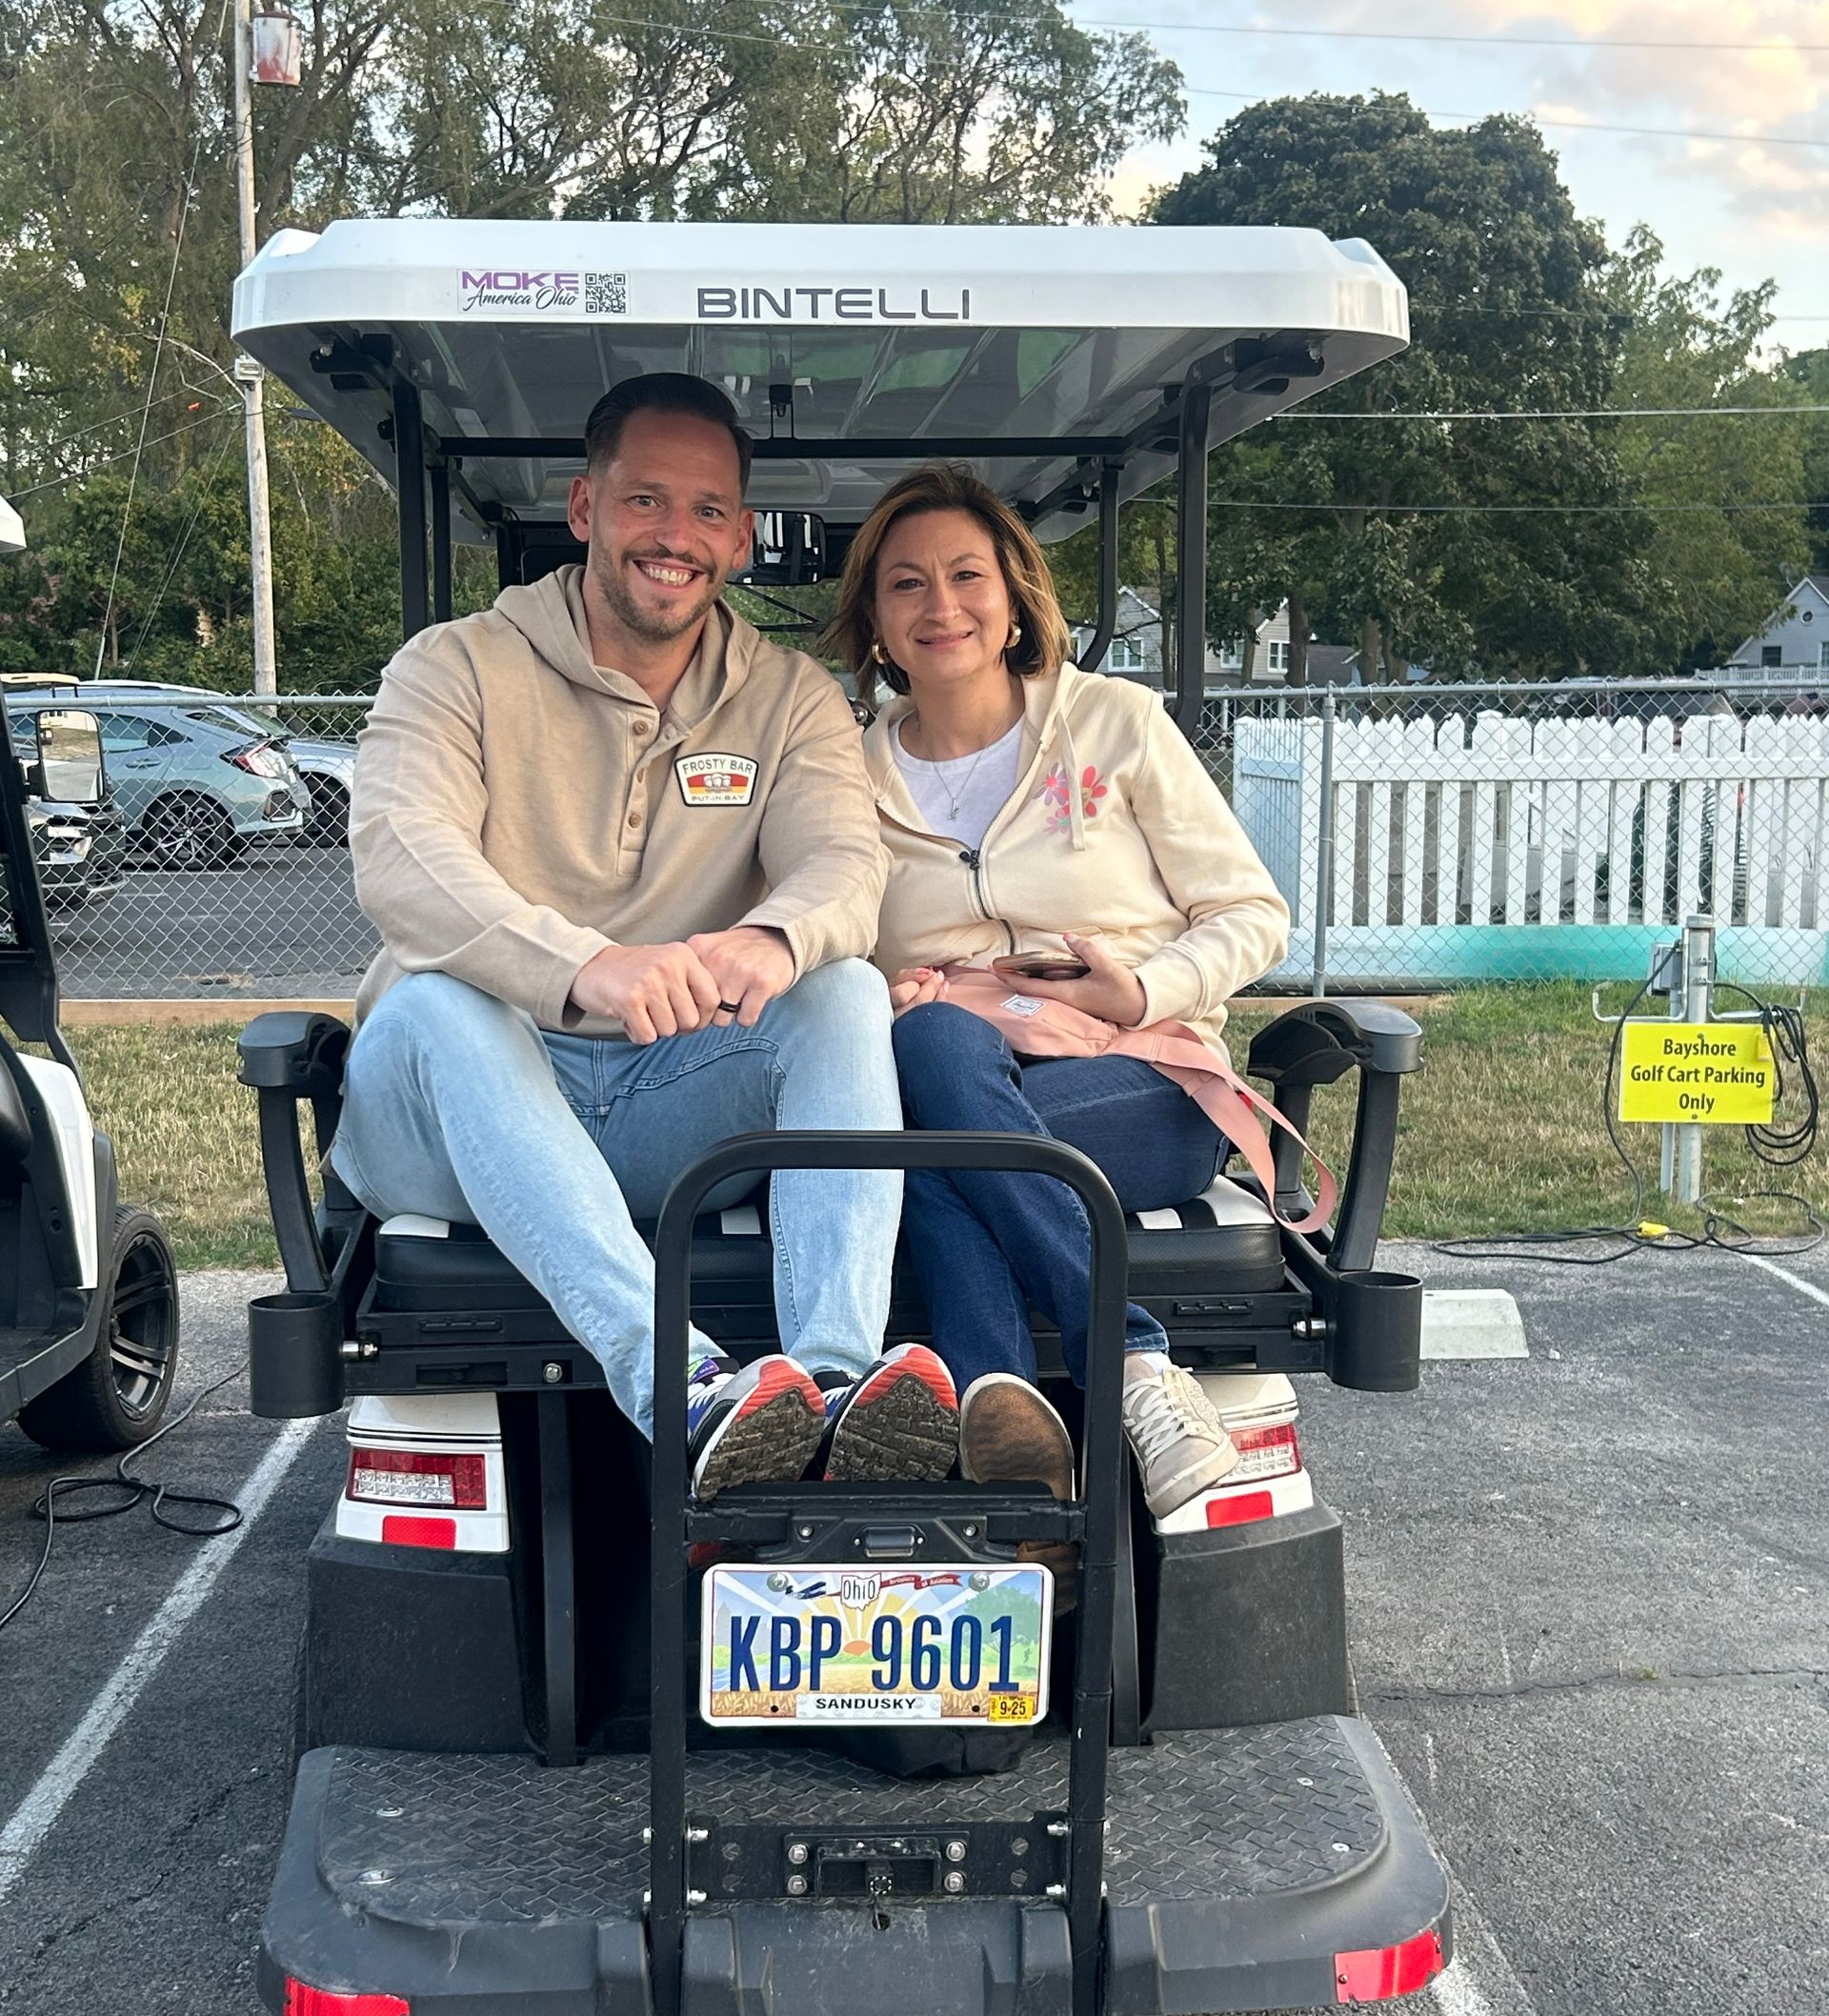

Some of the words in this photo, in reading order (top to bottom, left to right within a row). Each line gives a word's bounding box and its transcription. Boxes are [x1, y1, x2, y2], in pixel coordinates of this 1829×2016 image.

[462, 272, 579, 294] MOKE
[463, 284, 533, 312] America
[535, 286, 578, 310] Ohio
[697, 288, 971, 320] BINTELLI
[682, 758, 726, 775] FROSTY
[730, 760, 754, 774] BAR
[1663, 1038, 1737, 1059] Bayshore
[1631, 1065, 1664, 1081] Golf
[1667, 1066, 1700, 1082] Cart
[1704, 1067, 1765, 1088] Parking
[1678, 1093, 1715, 1115] Only
[730, 1616, 842, 1691] KBP
[872, 1615, 1019, 1692] 9601
[815, 1698, 916, 1709] SANDUSKY
